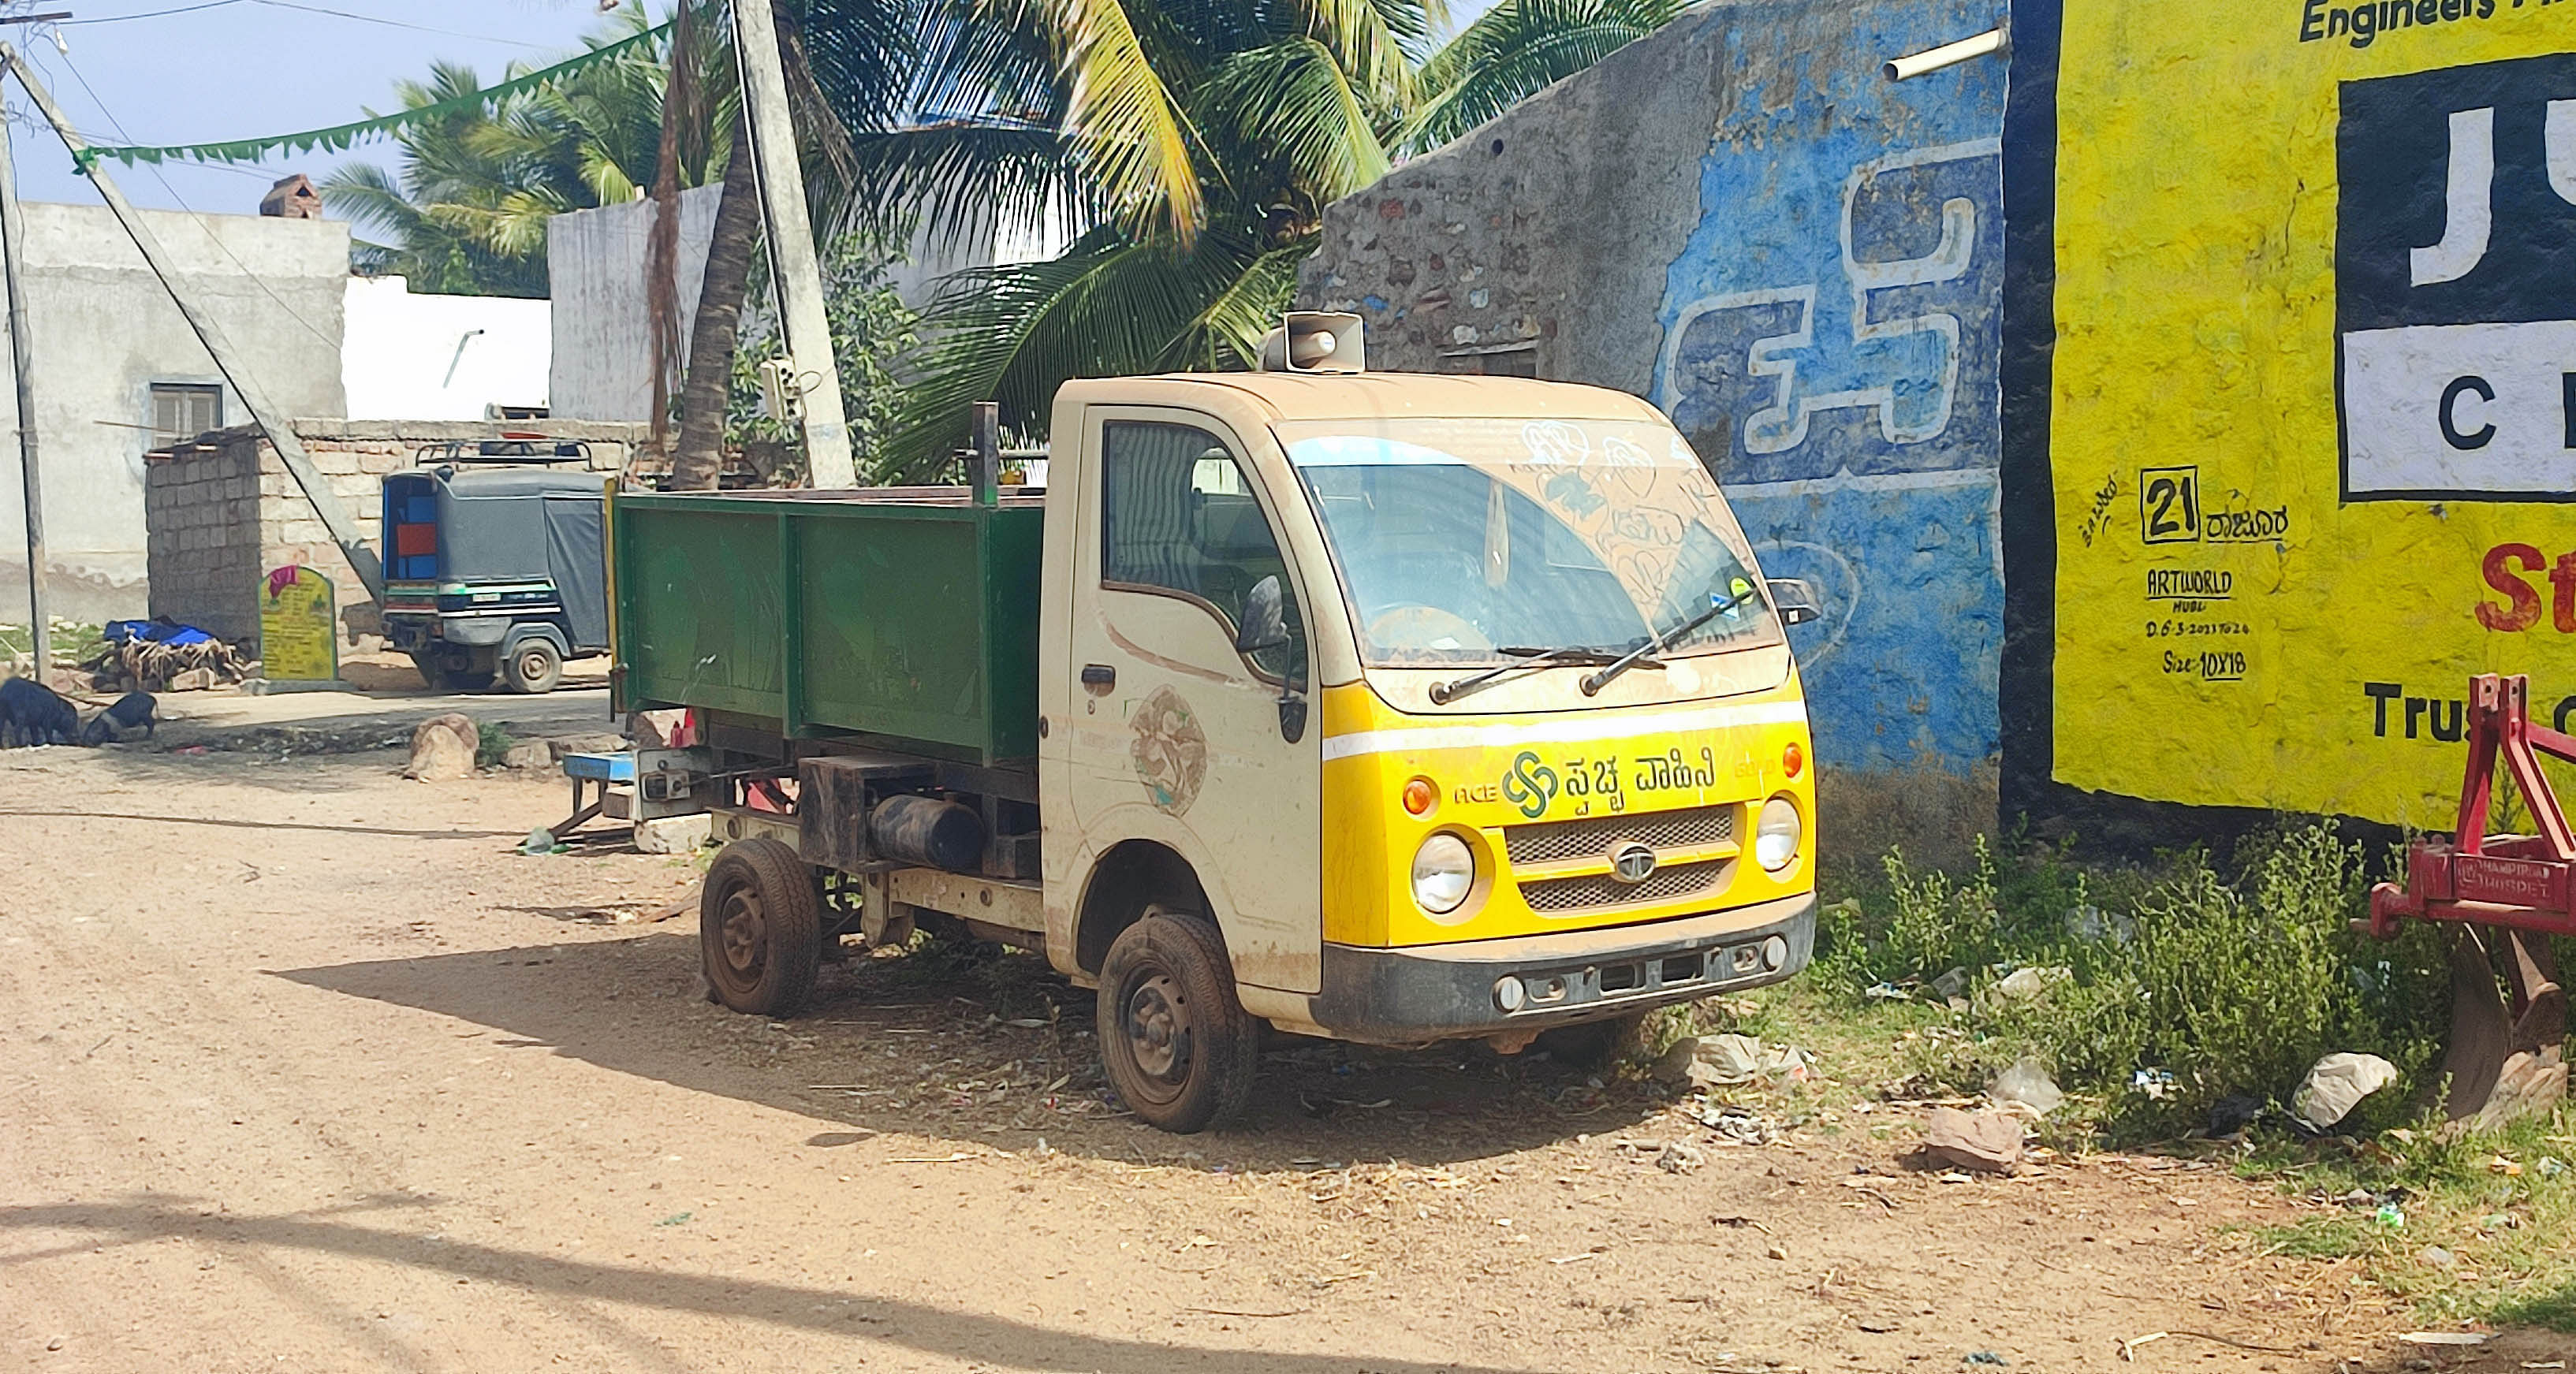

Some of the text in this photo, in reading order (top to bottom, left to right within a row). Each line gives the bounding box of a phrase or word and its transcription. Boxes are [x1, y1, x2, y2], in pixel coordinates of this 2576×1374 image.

[2410, 99, 2576, 288] J
[2146, 477, 2195, 537] 21
[2147, 568, 2232, 595] ARTWORLD
[2364, 682, 2470, 742] Tru
[1454, 785, 1497, 804] ACE
[1565, 747, 1715, 816] ಸ್ವಚ್ಛ ವಾಹಿನಿ
